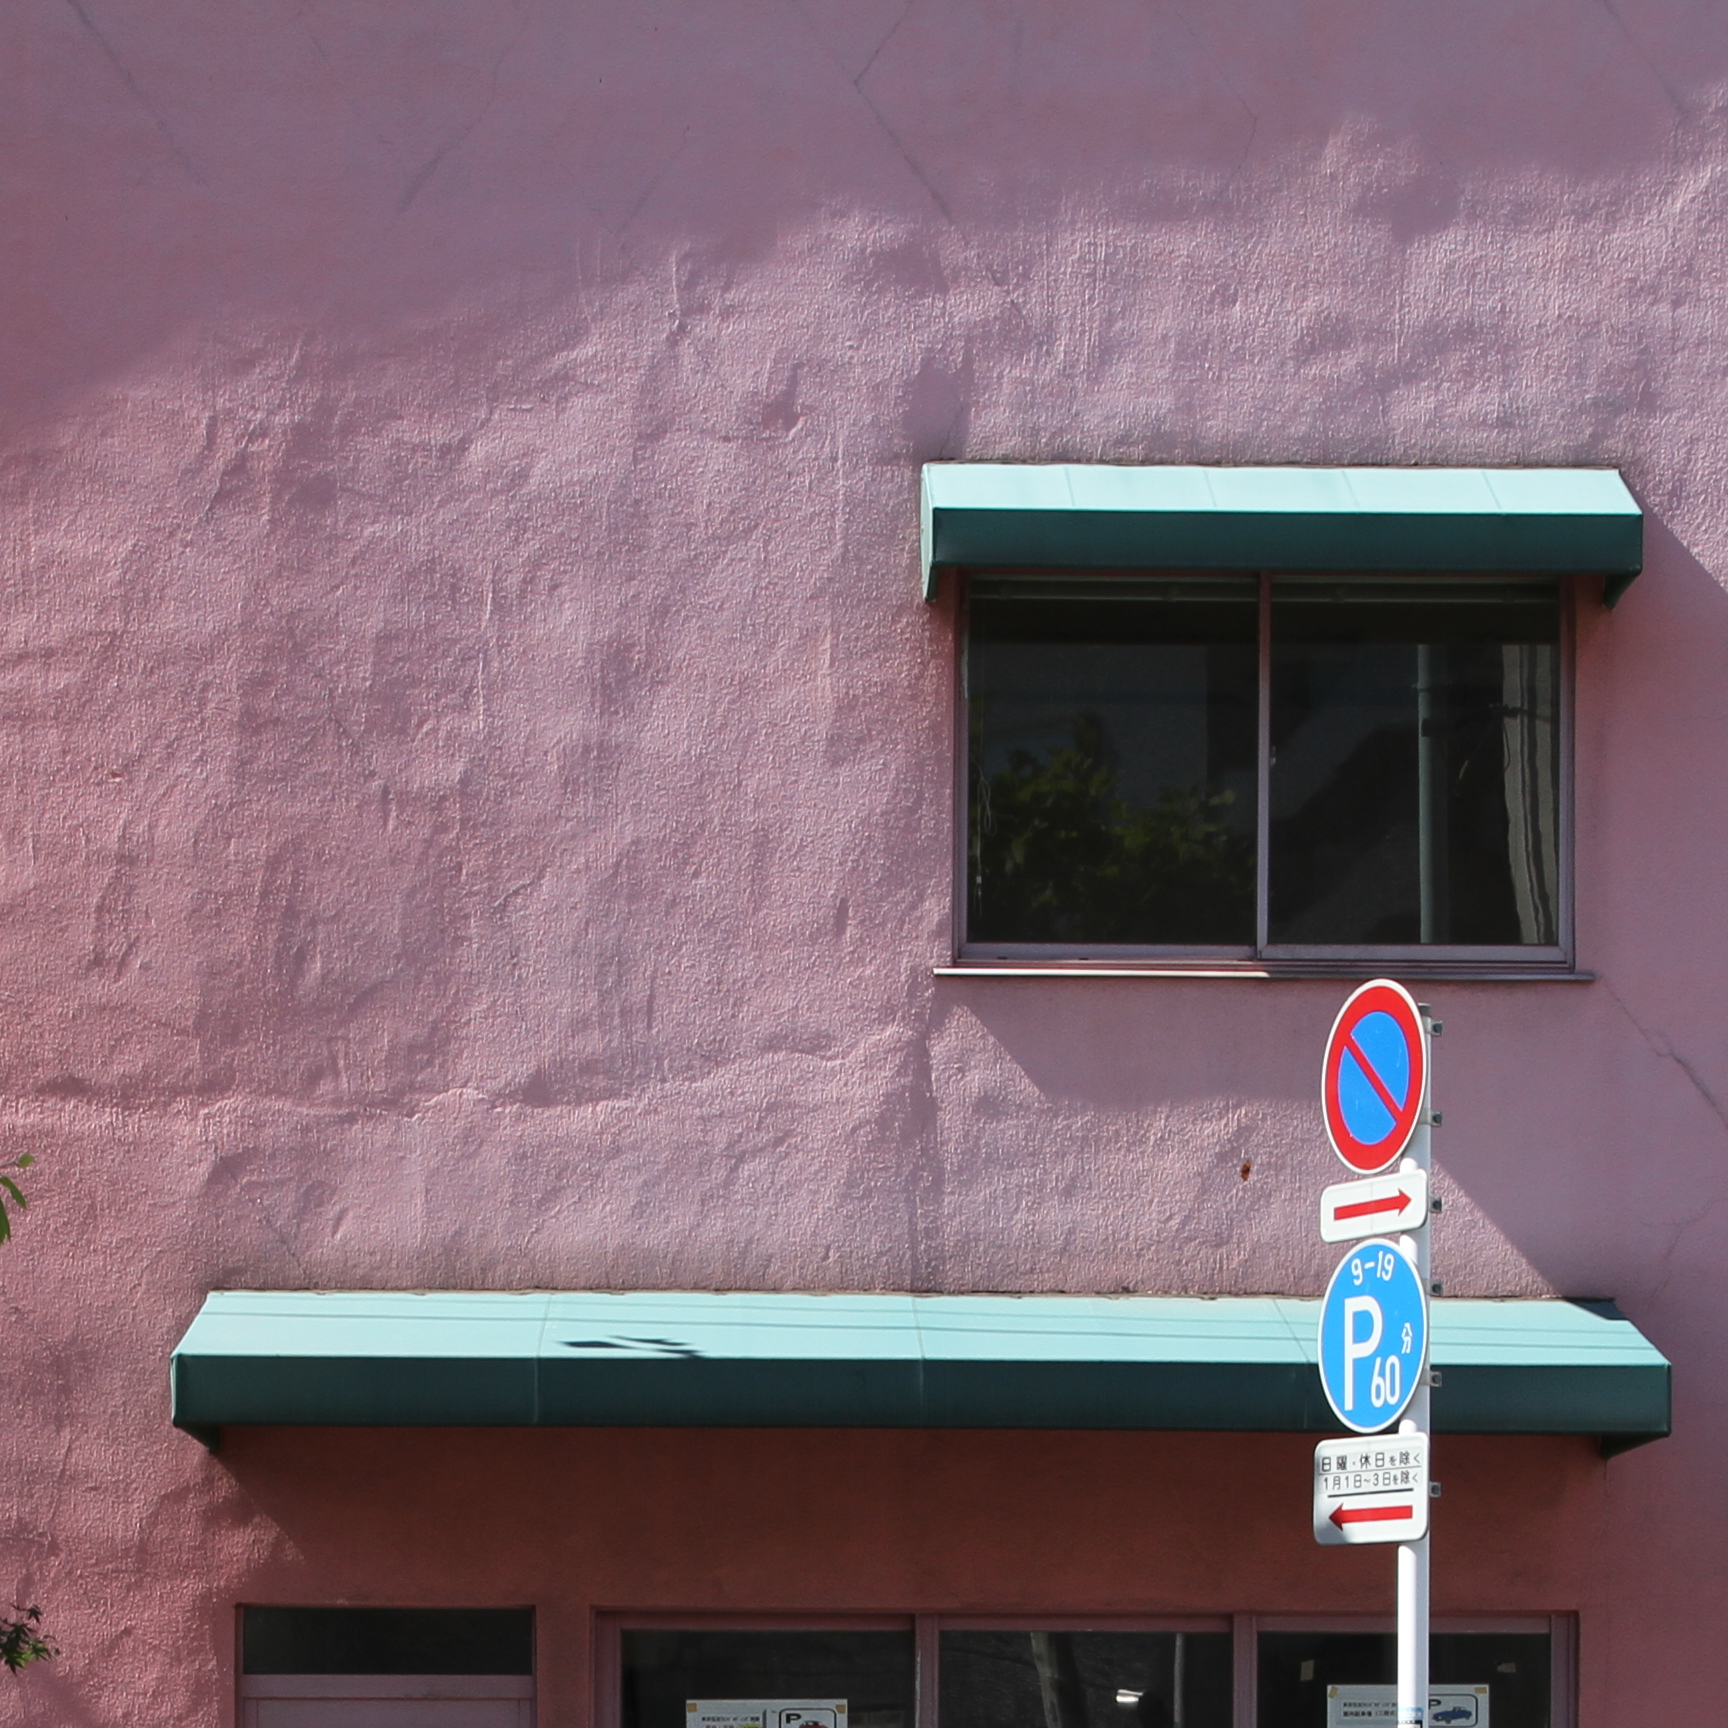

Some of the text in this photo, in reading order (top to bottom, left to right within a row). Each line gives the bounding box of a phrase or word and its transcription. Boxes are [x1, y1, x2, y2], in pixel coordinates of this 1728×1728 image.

[1351, 1250, 1394, 1286] 9-19
[1344, 1295, 1383, 1411] P
[1371, 1322, 1413, 1408] 60 分
[785, 1712, 801, 1725] P
[1428, 1699, 1442, 1710] P
